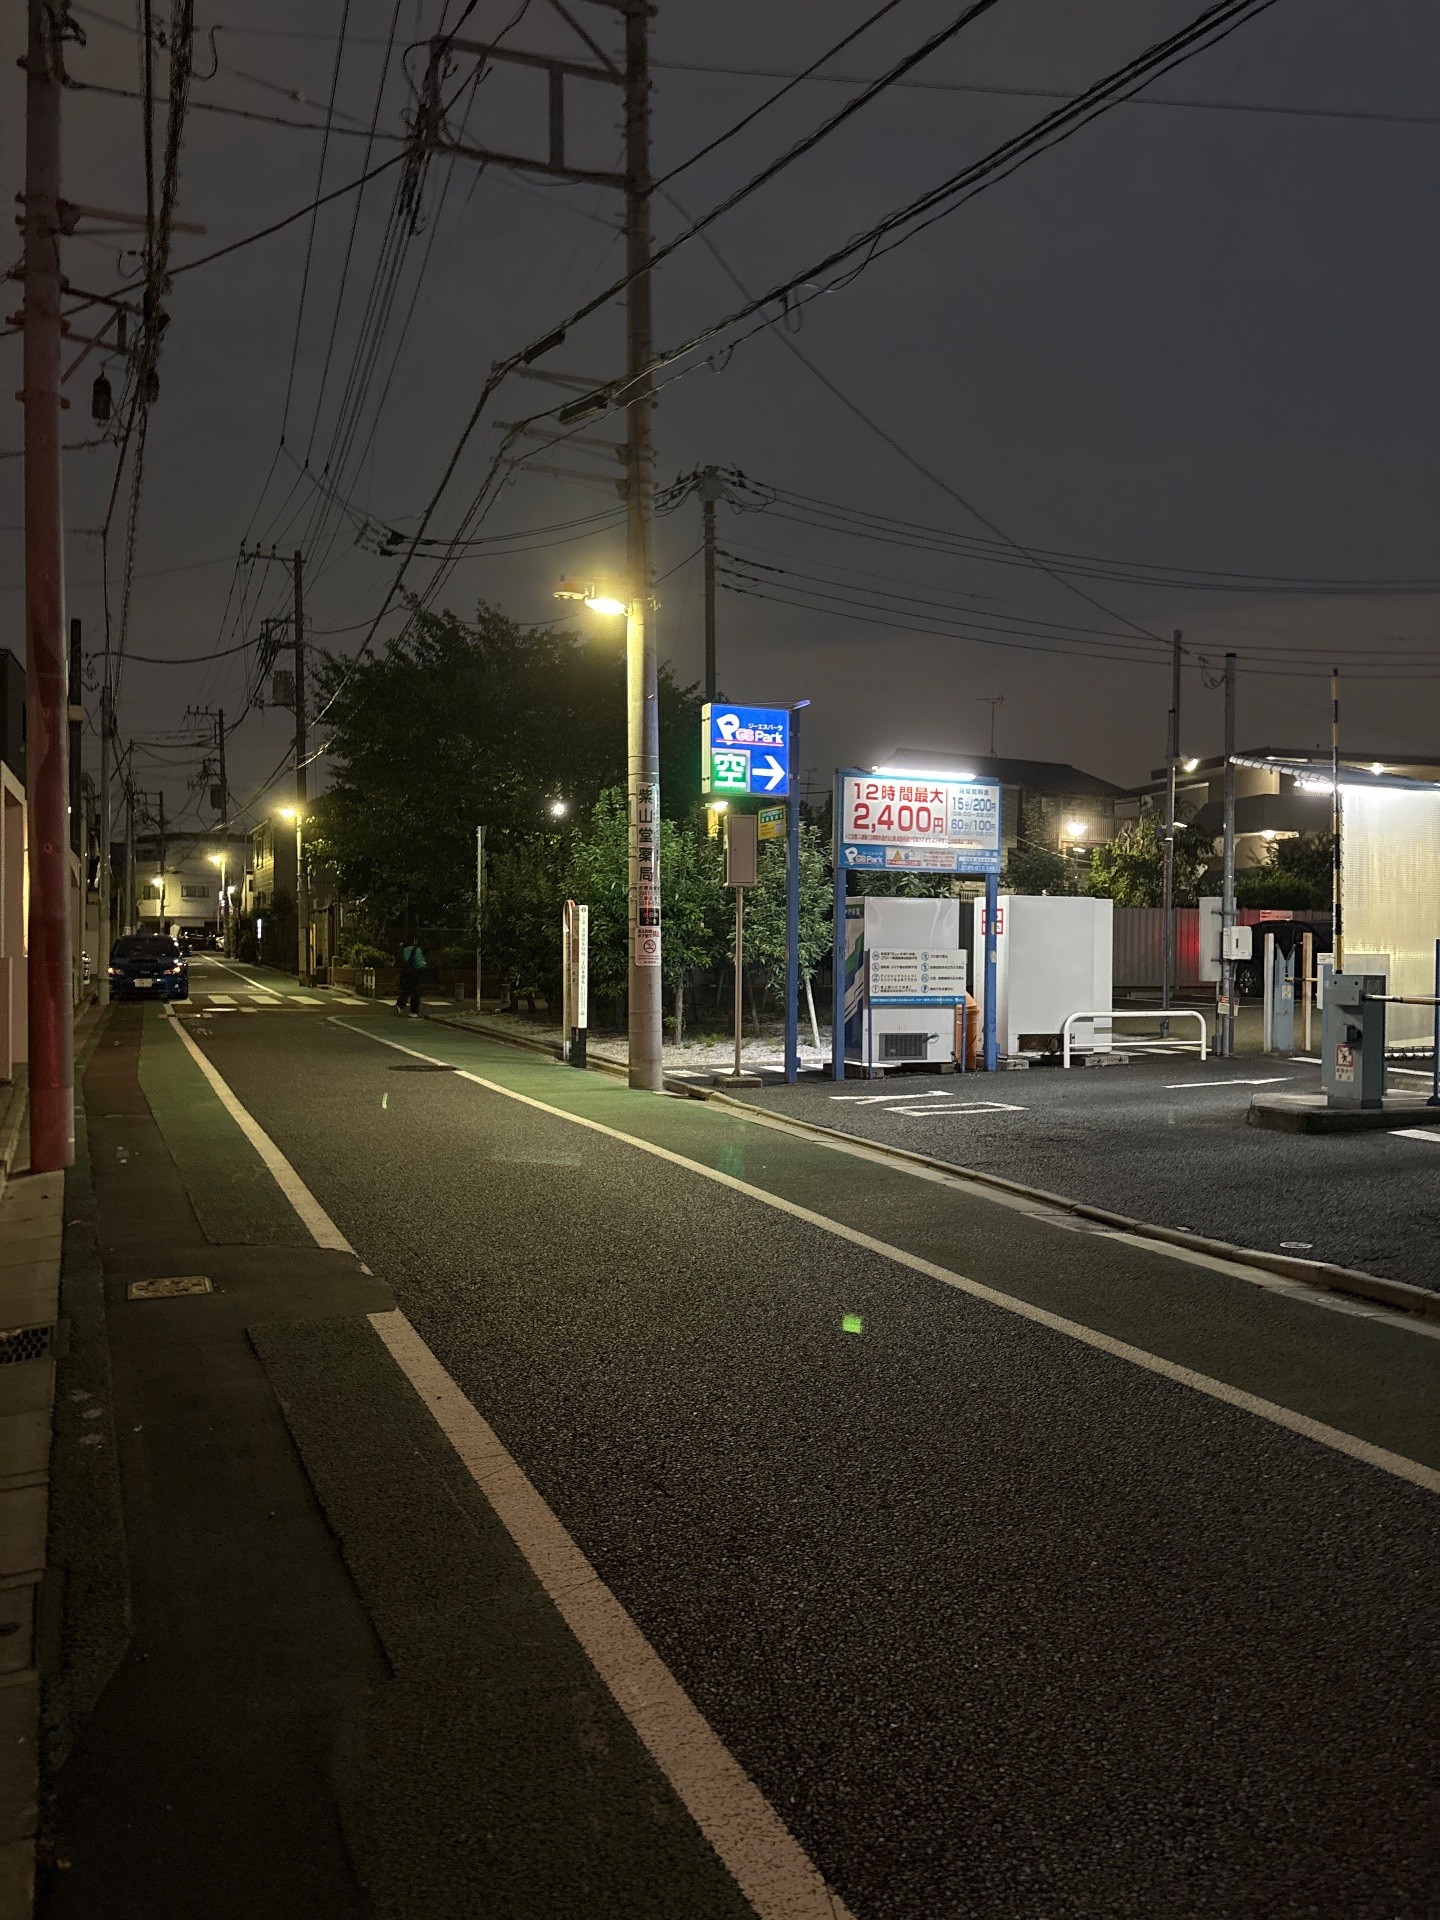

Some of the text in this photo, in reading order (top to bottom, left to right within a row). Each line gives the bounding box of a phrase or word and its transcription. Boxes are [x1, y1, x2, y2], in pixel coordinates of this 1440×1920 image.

[747, 722, 783, 732] ジーエスパーク
[754, 730, 783, 744] Park
[713, 753, 747, 789] 空
[853, 782, 944, 804] 12時間最大
[853, 802, 944, 834] 2,400円
